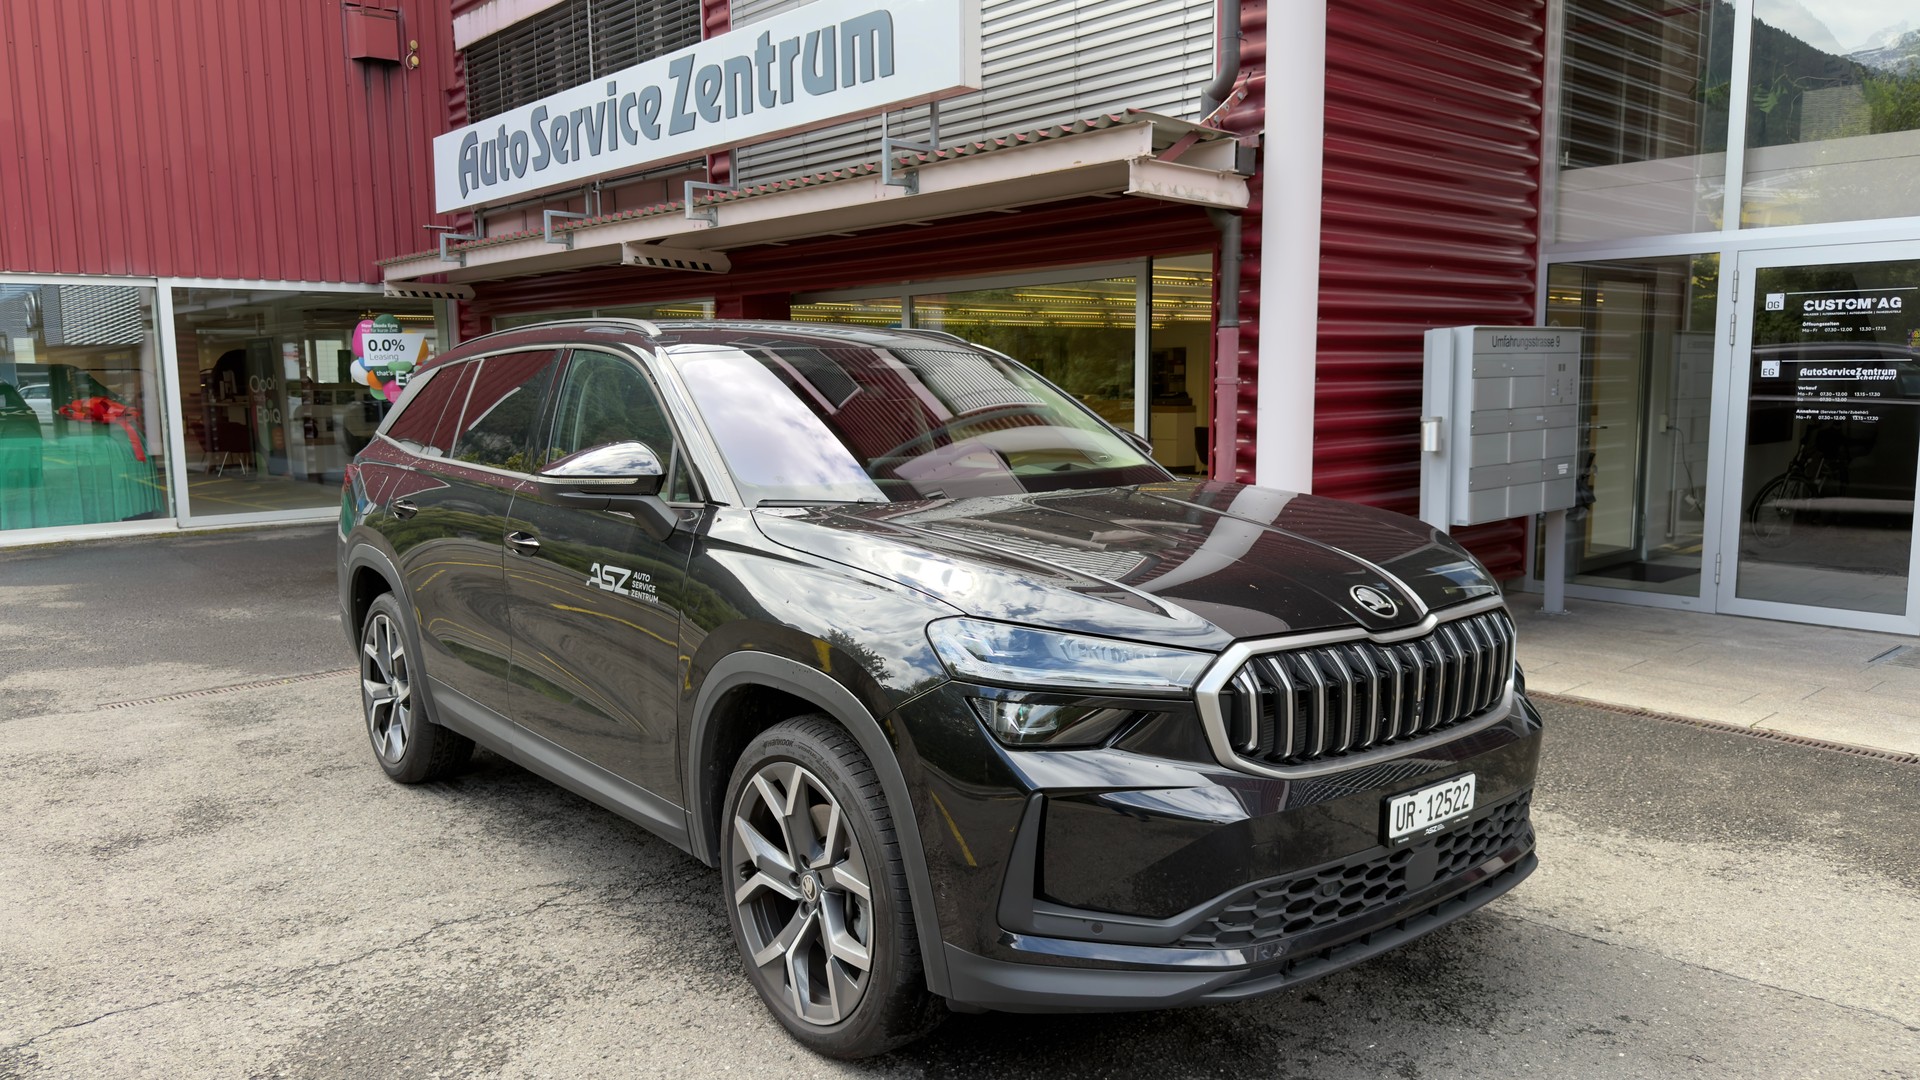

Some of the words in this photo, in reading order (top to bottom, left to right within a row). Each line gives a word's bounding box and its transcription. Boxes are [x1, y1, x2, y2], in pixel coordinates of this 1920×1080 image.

[1877, 296, 1902, 309] AG
[368, 339, 405, 352] 0.0%
[1492, 335, 1555, 350] Umfahrungsstrasse
[1555, 335, 1561, 348] 9
[369, 353, 399, 362] Leasing
[1762, 368, 1775, 376] EG
[585, 562, 632, 595] ASZ
[633, 571, 651, 583] AUTO
[631, 581, 657, 593] SERVICE
[630, 590, 659, 604] ZENTRUM
